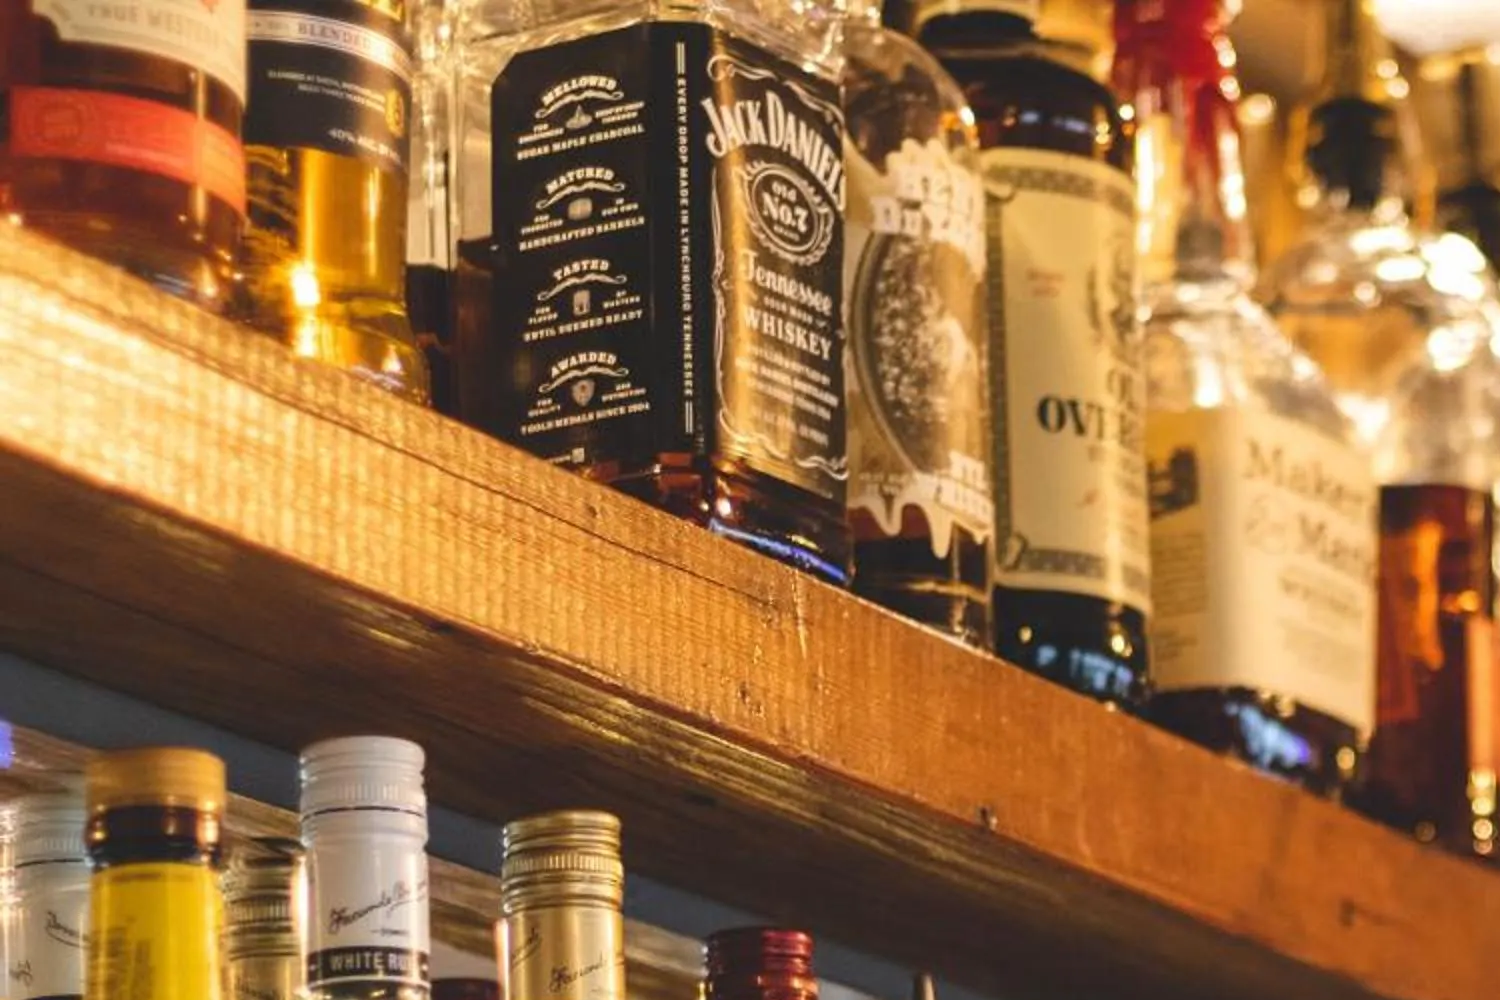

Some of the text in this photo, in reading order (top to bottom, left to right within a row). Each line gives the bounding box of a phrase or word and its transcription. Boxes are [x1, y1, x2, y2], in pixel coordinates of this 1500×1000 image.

[542, 75, 617, 106] MELLOWED
[676, 78, 688, 124] EVERY
[551, 135, 587, 153] MAPLE
[589, 123, 646, 144] CHARCOAL
[677, 126, 689, 164] DROP
[700, 97, 769, 158] JACK
[545, 167, 615, 194] MATURED
[679, 167, 690, 206] MADE
[519, 216, 646, 252] HANDCRAFTED BARRELS
[680, 208, 690, 226] IN
[553, 259, 610, 280] TASTED
[741, 248, 833, 317] Tennessee
[523, 309, 643, 343] UNTIL DEEMED READY
[744, 305, 833, 361] WHISKEY
[551, 352, 618, 378] AWARDED
[682, 315, 694, 397] TENNESSEE
[330, 950, 386, 972] WHITE
